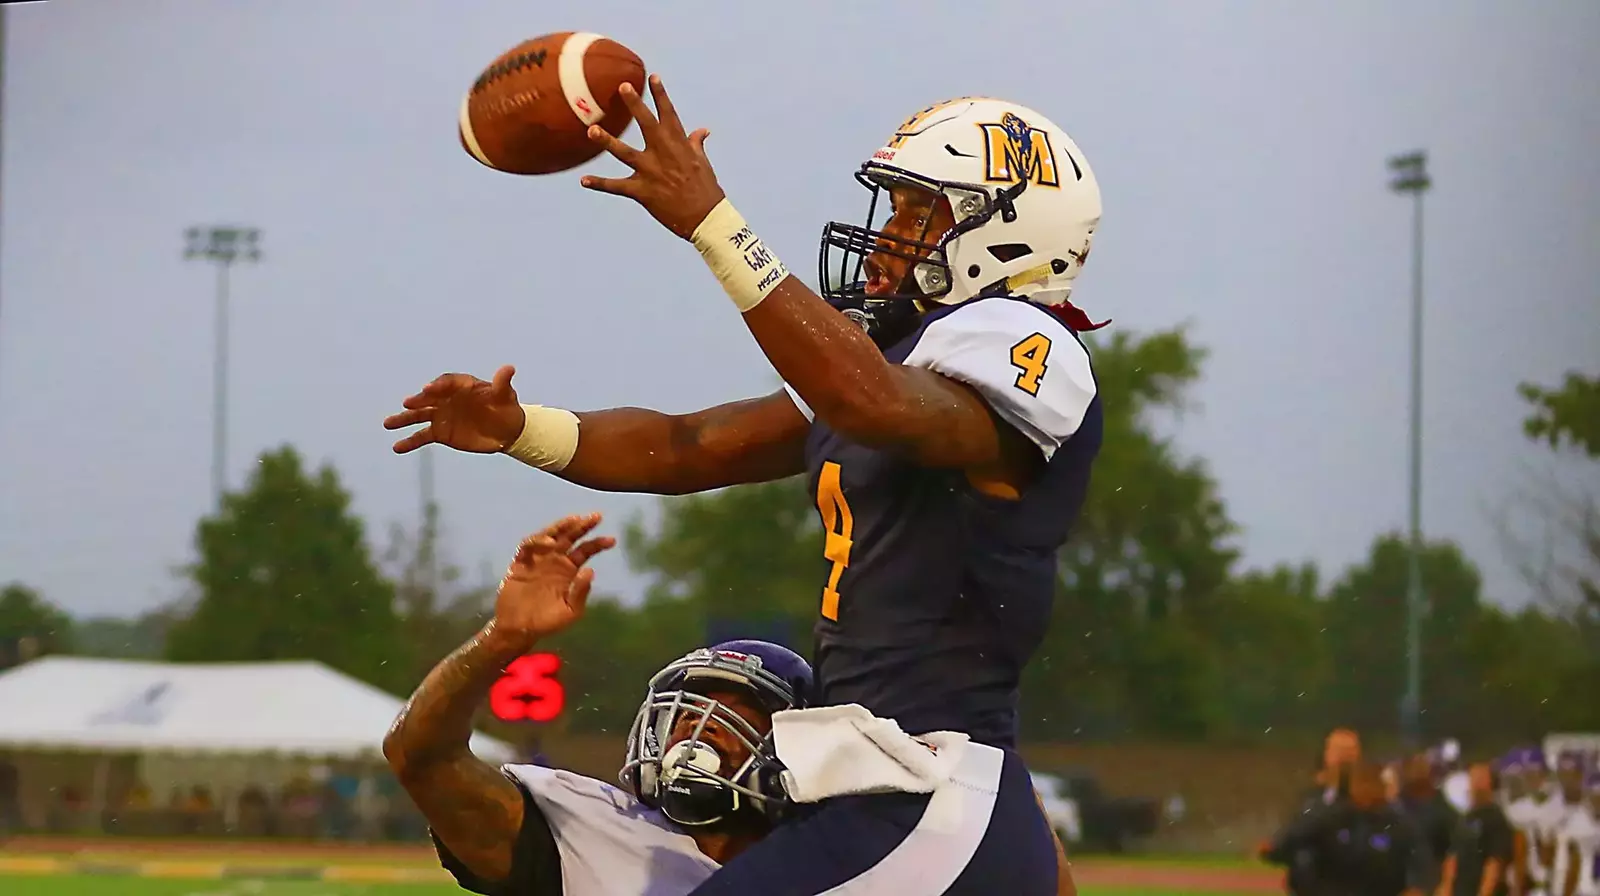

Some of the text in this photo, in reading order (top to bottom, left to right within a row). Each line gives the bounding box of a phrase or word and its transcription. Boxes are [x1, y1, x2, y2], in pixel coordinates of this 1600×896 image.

[978, 121, 1060, 188] M
[1010, 331, 1052, 398] 4
[817, 460, 854, 622] 4
